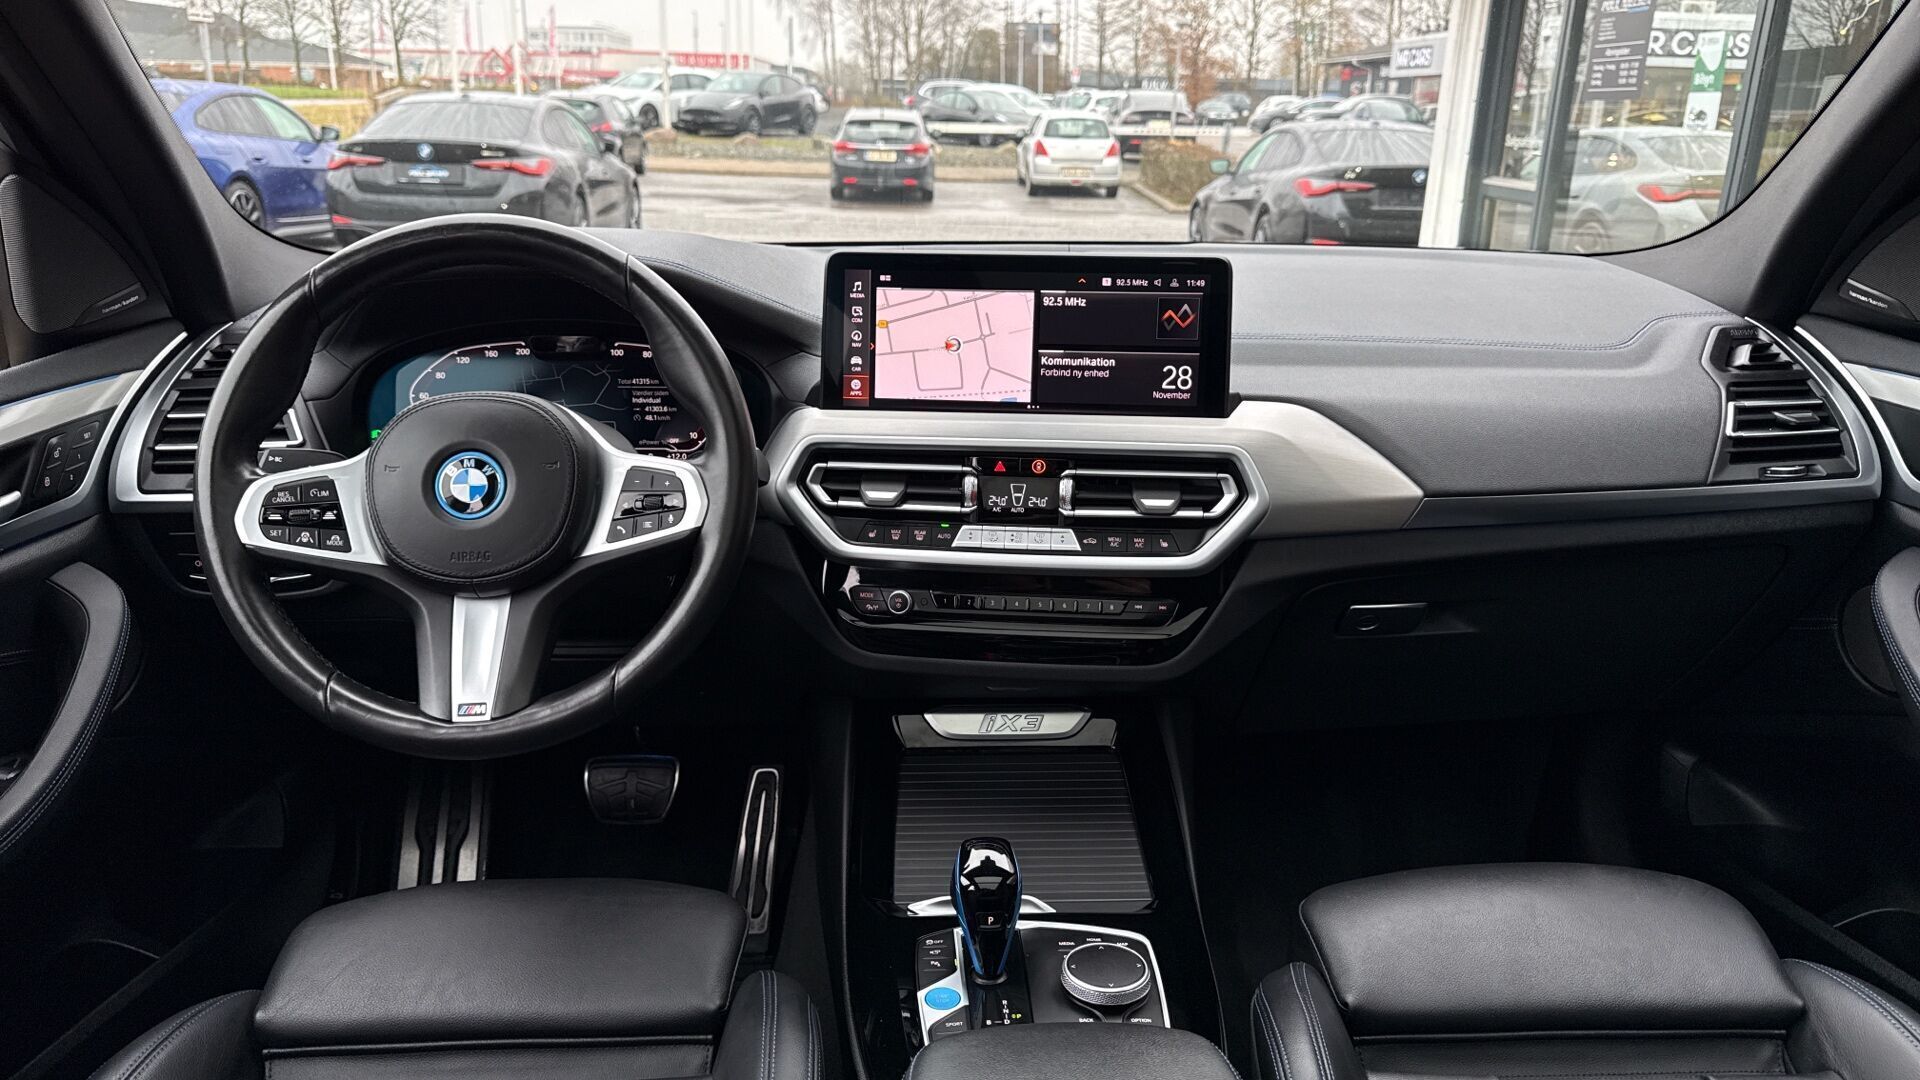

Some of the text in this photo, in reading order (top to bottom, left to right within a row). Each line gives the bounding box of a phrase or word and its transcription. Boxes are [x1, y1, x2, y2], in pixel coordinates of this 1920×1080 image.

[1043, 296, 1086, 307] 92.5 MHz
[485, 350, 498, 358] 160
[642, 350, 652, 358] 80
[1041, 355, 1116, 367] Kommunikation
[1041, 368, 1109, 379] Forbind ny enhed
[1161, 365, 1192, 389] 28
[1152, 391, 1191, 400] November
[272, 496, 295, 504] CANCEL
[449, 550, 492, 562] AIRBAG
[978, 713, 1045, 734] iX3
[988, 916, 994, 926] P
